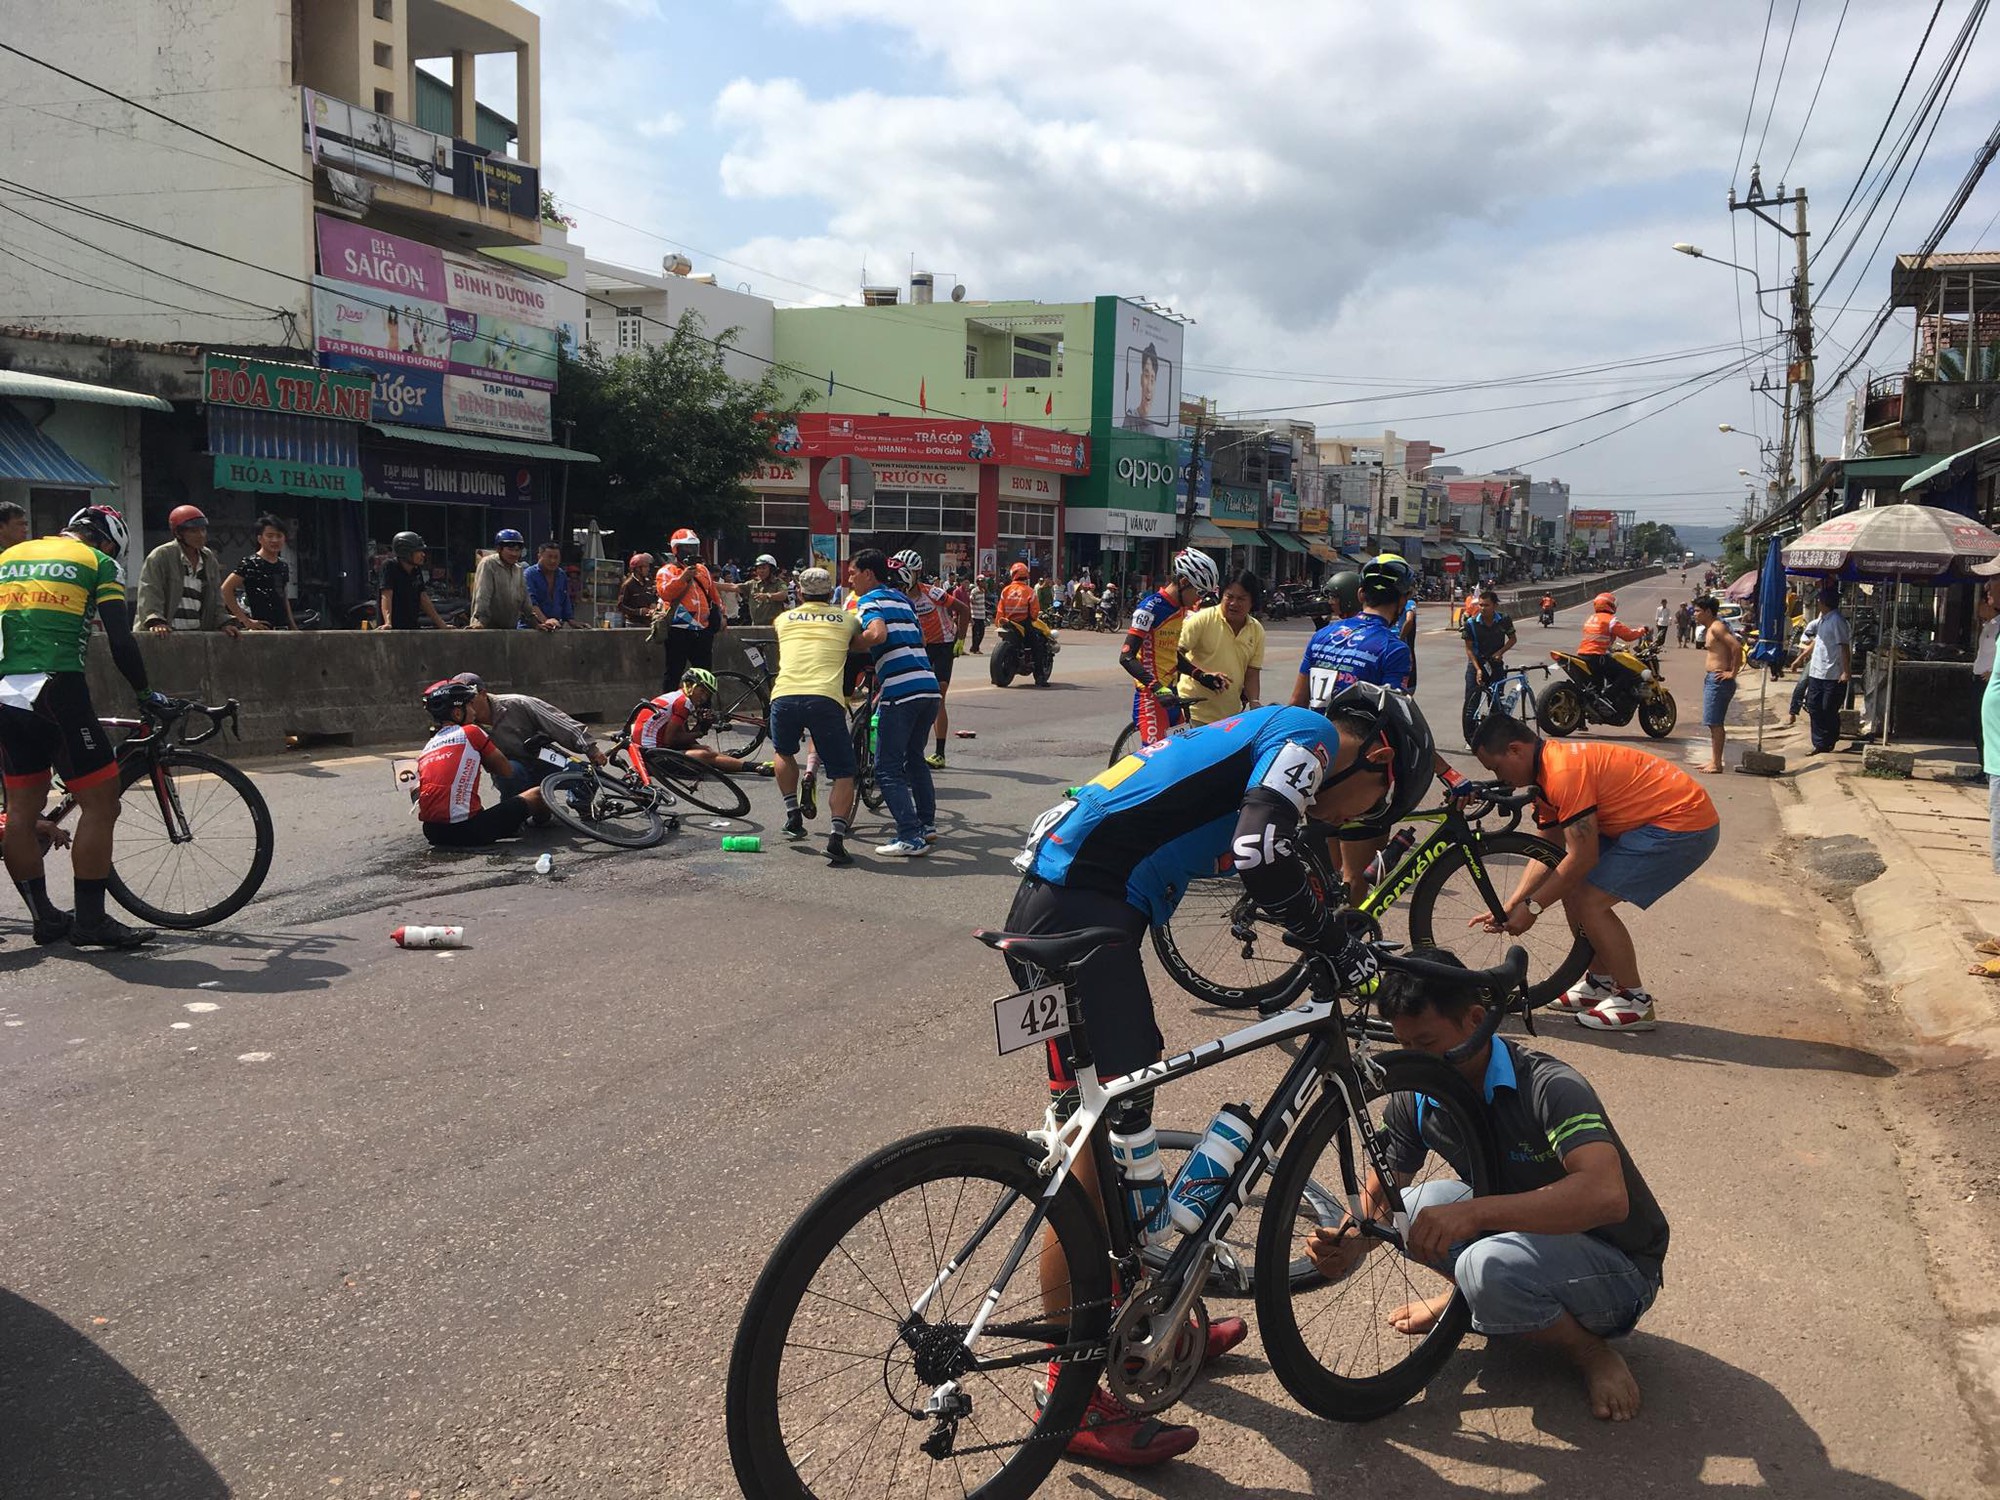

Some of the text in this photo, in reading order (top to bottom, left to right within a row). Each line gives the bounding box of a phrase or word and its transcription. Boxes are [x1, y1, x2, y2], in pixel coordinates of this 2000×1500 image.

[371, 238, 396, 258] BIA
[453, 269, 492, 297] BÌNH
[495, 283, 545, 309] DƯƠNG
[325, 340, 444, 369] TẠP HÓA BÌNH DƯƠNG
[208, 361, 271, 407] HÓA
[482, 383, 524, 399] TẠP HÓA
[878, 445, 907, 453] NHANH
[926, 446, 943, 455] ĐƠN
[944, 446, 962, 455] GIẢN
[915, 429, 938, 443] TRẢ
[939, 432, 962, 444] GÓP
[230, 461, 346, 491] HÓA THÀNH
[383, 465, 400, 479] TẠP
[402, 464, 419, 479] HÓA
[424, 465, 458, 492] BÌNH
[460, 471, 506, 497] DƯƠNG
[769, 465, 794, 480] DA
[1012, 477, 1049, 493] HON DA
[1130, 514, 1144, 531] VĂN
[1144, 518, 1158, 532] QUY
[0, 563, 78, 580] CALYTOS
[788, 612, 843, 624] CALYTOS
[1136, 614, 1150, 627] 63
[1284, 762, 1316, 797] 42
[1463, 844, 1482, 879] cervélo
[1372, 841, 1448, 920] cervélo
[1348, 952, 1379, 986] sky
[1020, 994, 1060, 1037] 42
[1358, 1108, 1395, 1188] FOCUS
